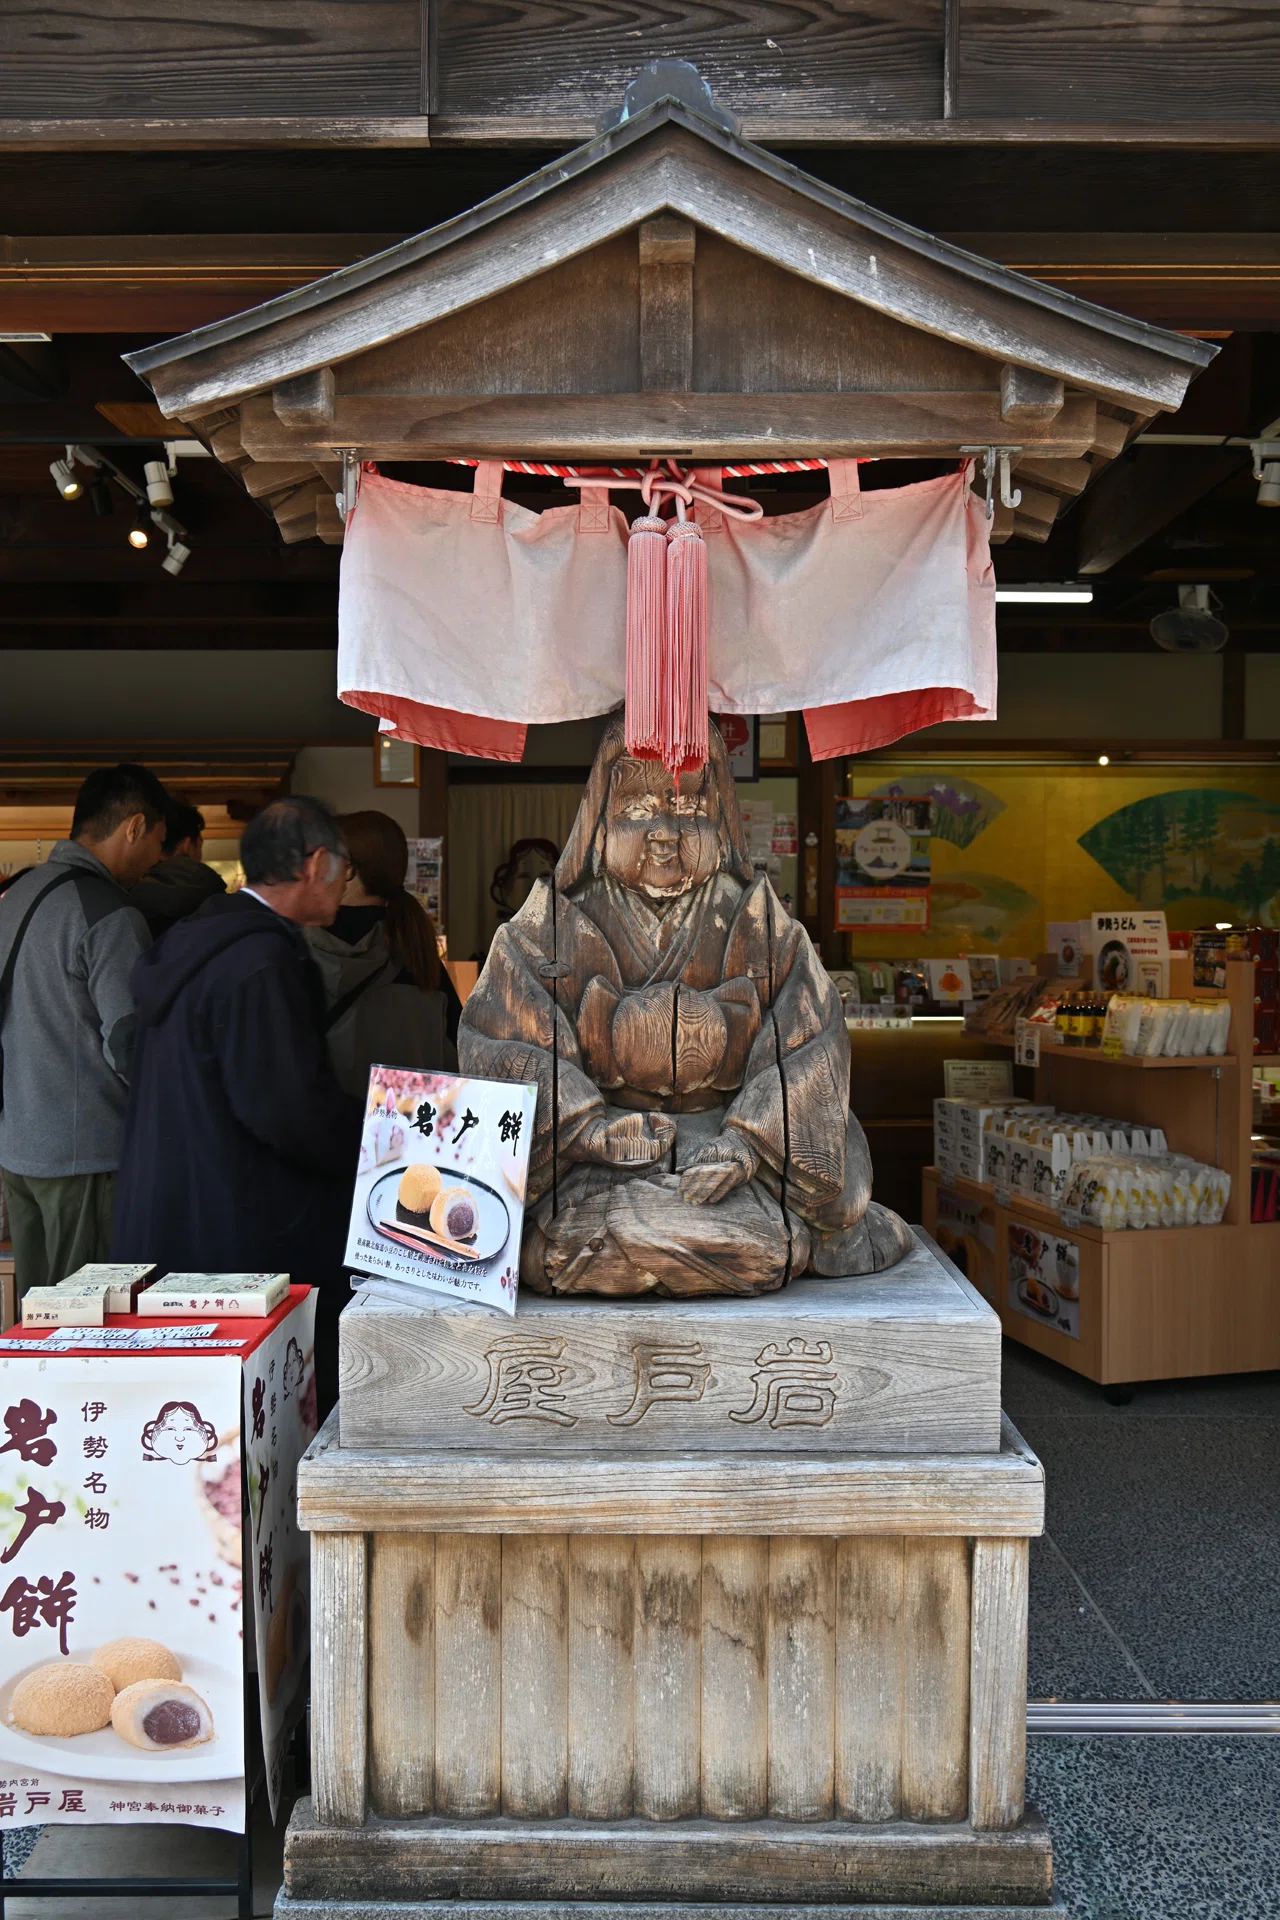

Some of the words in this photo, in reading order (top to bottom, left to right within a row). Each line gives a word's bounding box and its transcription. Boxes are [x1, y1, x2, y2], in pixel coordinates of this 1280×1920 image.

[1097, 916, 1136, 930] 伊勢うどん
[409, 1101, 523, 1157] 岩戸餅
[81, 1401, 110, 1530] 伊勢名物
[0, 1398, 78, 1656] 岩戸餅
[109, 1800, 226, 1816] 神宮奉納御菓子
